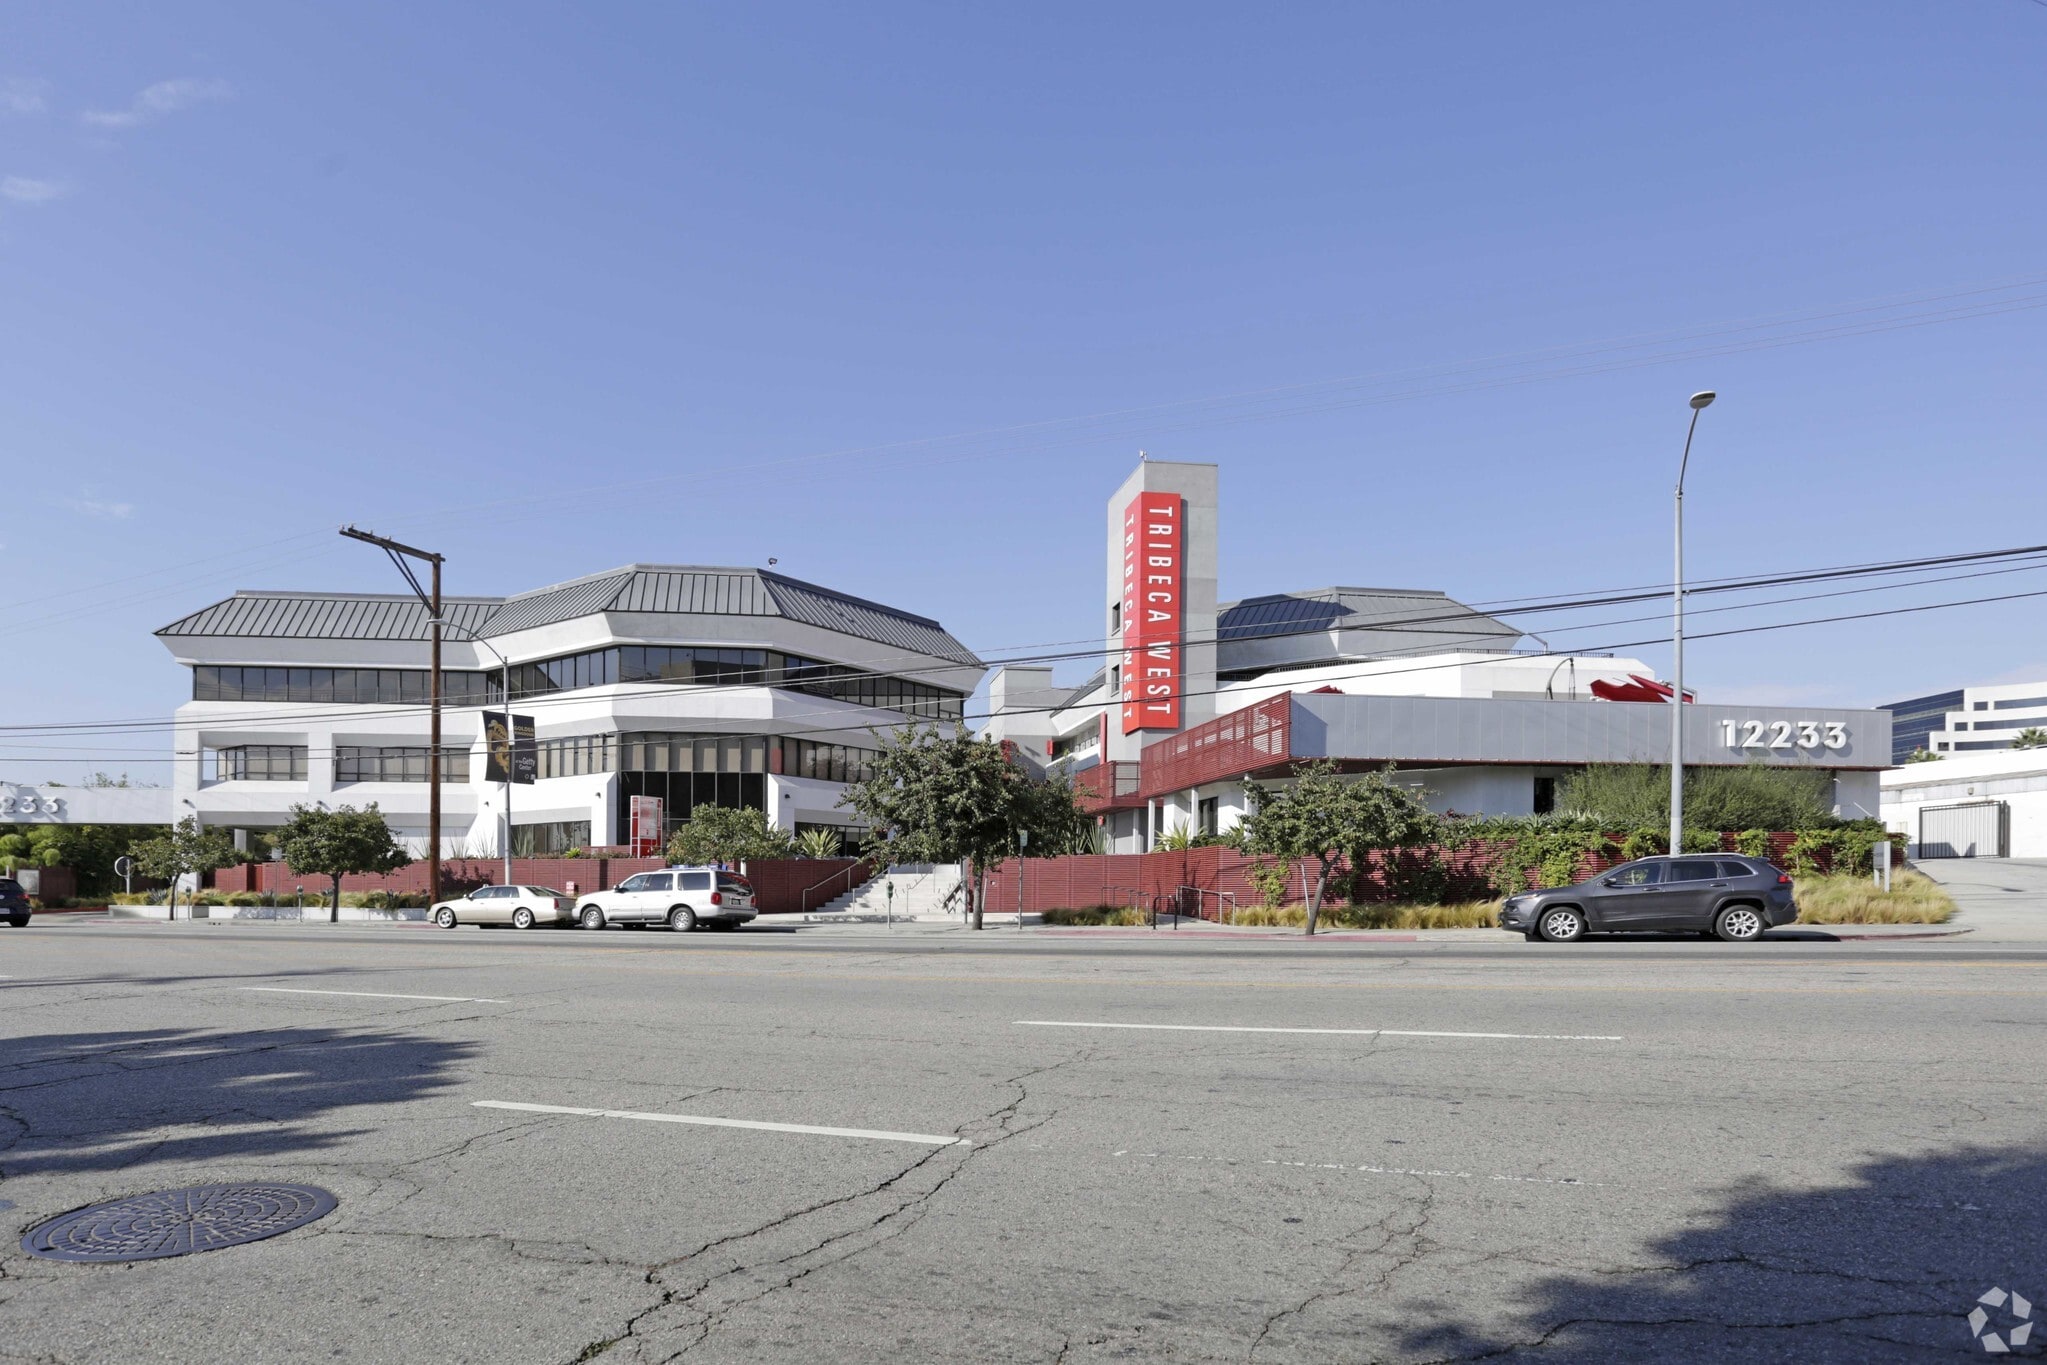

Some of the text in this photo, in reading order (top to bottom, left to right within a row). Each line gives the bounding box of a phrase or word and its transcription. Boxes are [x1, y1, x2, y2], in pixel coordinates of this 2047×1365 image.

[1123, 513, 1134, 718] TRIBECA WEST
[1147, 506, 1173, 715] TRIBECA WEST
[522, 757, 535, 767] Getty
[1722, 719, 1848, 749] 12233
